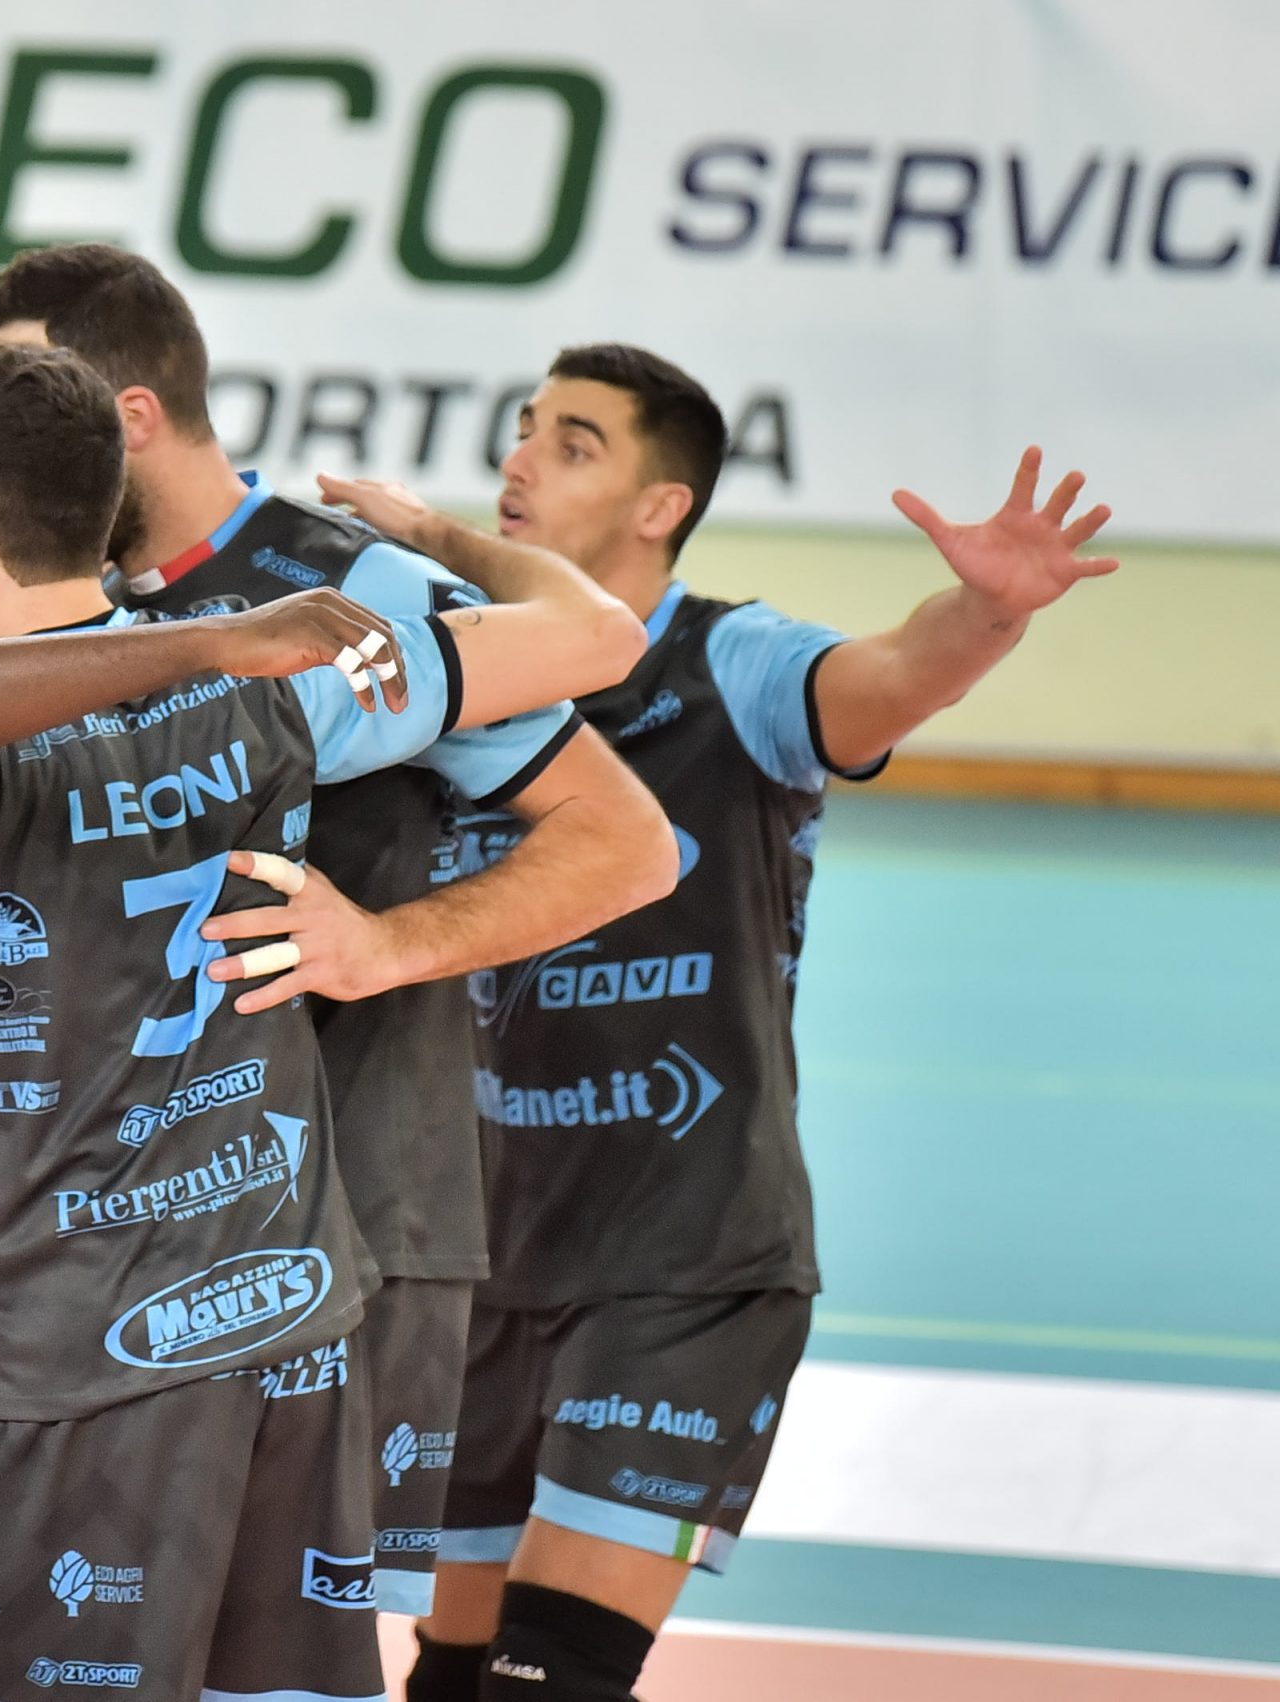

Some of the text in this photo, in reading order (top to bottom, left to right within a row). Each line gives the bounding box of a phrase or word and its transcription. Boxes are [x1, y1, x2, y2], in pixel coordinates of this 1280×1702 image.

[666, 139, 1280, 272] SERVIC
[68, 741, 253, 844] LEONI
[123, 851, 228, 1058] 3
[541, 954, 708, 1006] CAVI
[186, 1066, 259, 1109] SPORT
[473, 1066, 653, 1128] lanet.it
[255, 1138, 283, 1167] srl
[145, 1260, 314, 1347] Maury's
[647, 1400, 718, 1442] Auto
[407, 1533, 441, 1549] SPO
[94, 1585, 144, 1603] SERVICE
[63, 1666, 139, 1683] 2T SPORT
